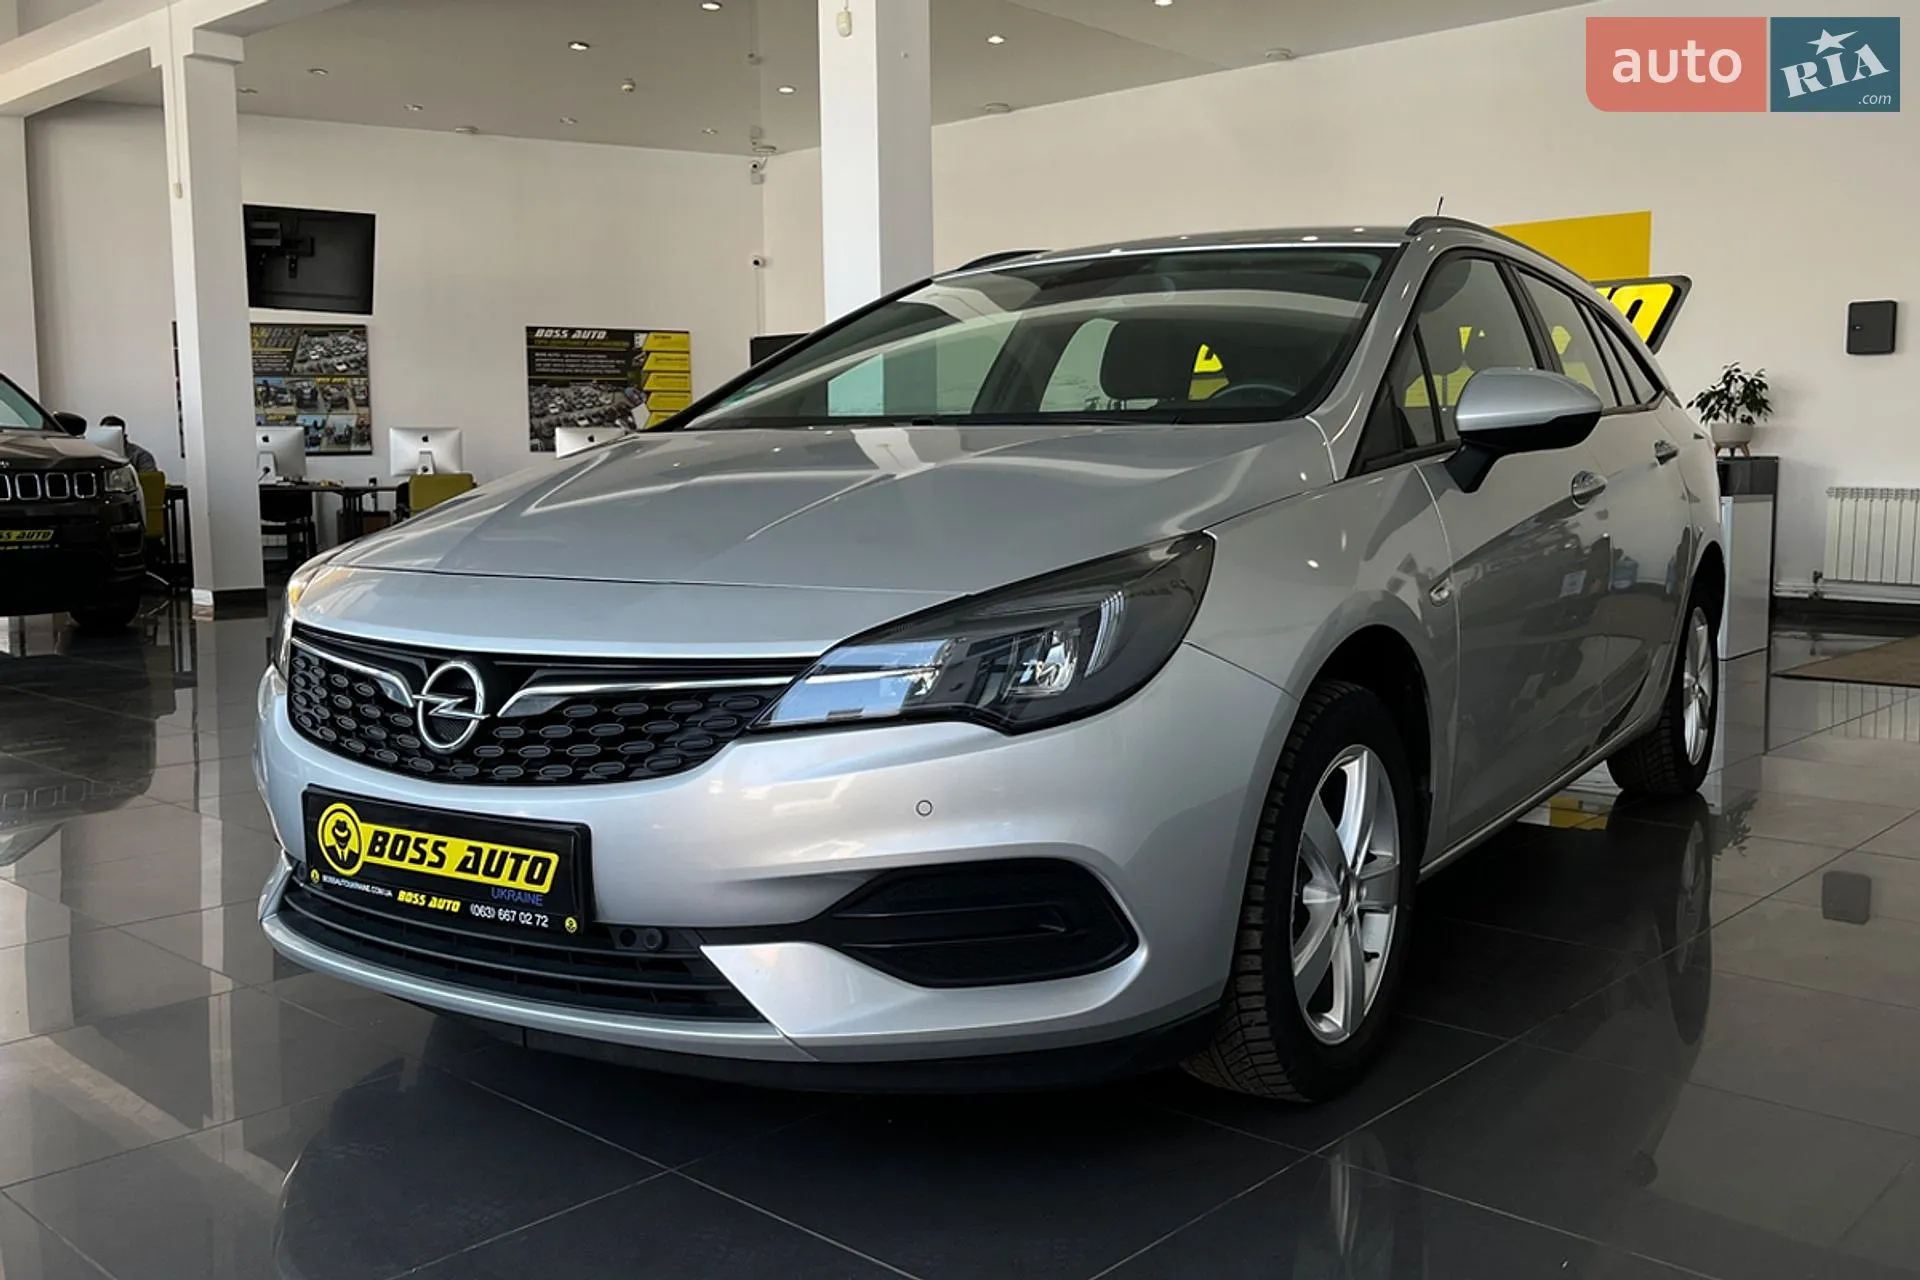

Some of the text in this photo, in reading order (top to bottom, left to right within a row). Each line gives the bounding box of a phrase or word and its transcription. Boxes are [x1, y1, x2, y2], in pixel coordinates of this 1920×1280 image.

[534, 328, 607, 340] BOSS AUTO
[16, 531, 50, 540] AUTO
[367, 829, 552, 886] BOSS AUTO
[491, 886, 544, 906] UKRAINE
[397, 889, 426, 906] BOSS
[428, 896, 460, 913] AUTO
[470, 903, 495, 918] (063)
[498, 908, 516, 922] 667
[519, 912, 533, 925] 02
[535, 914, 549, 928] 72
